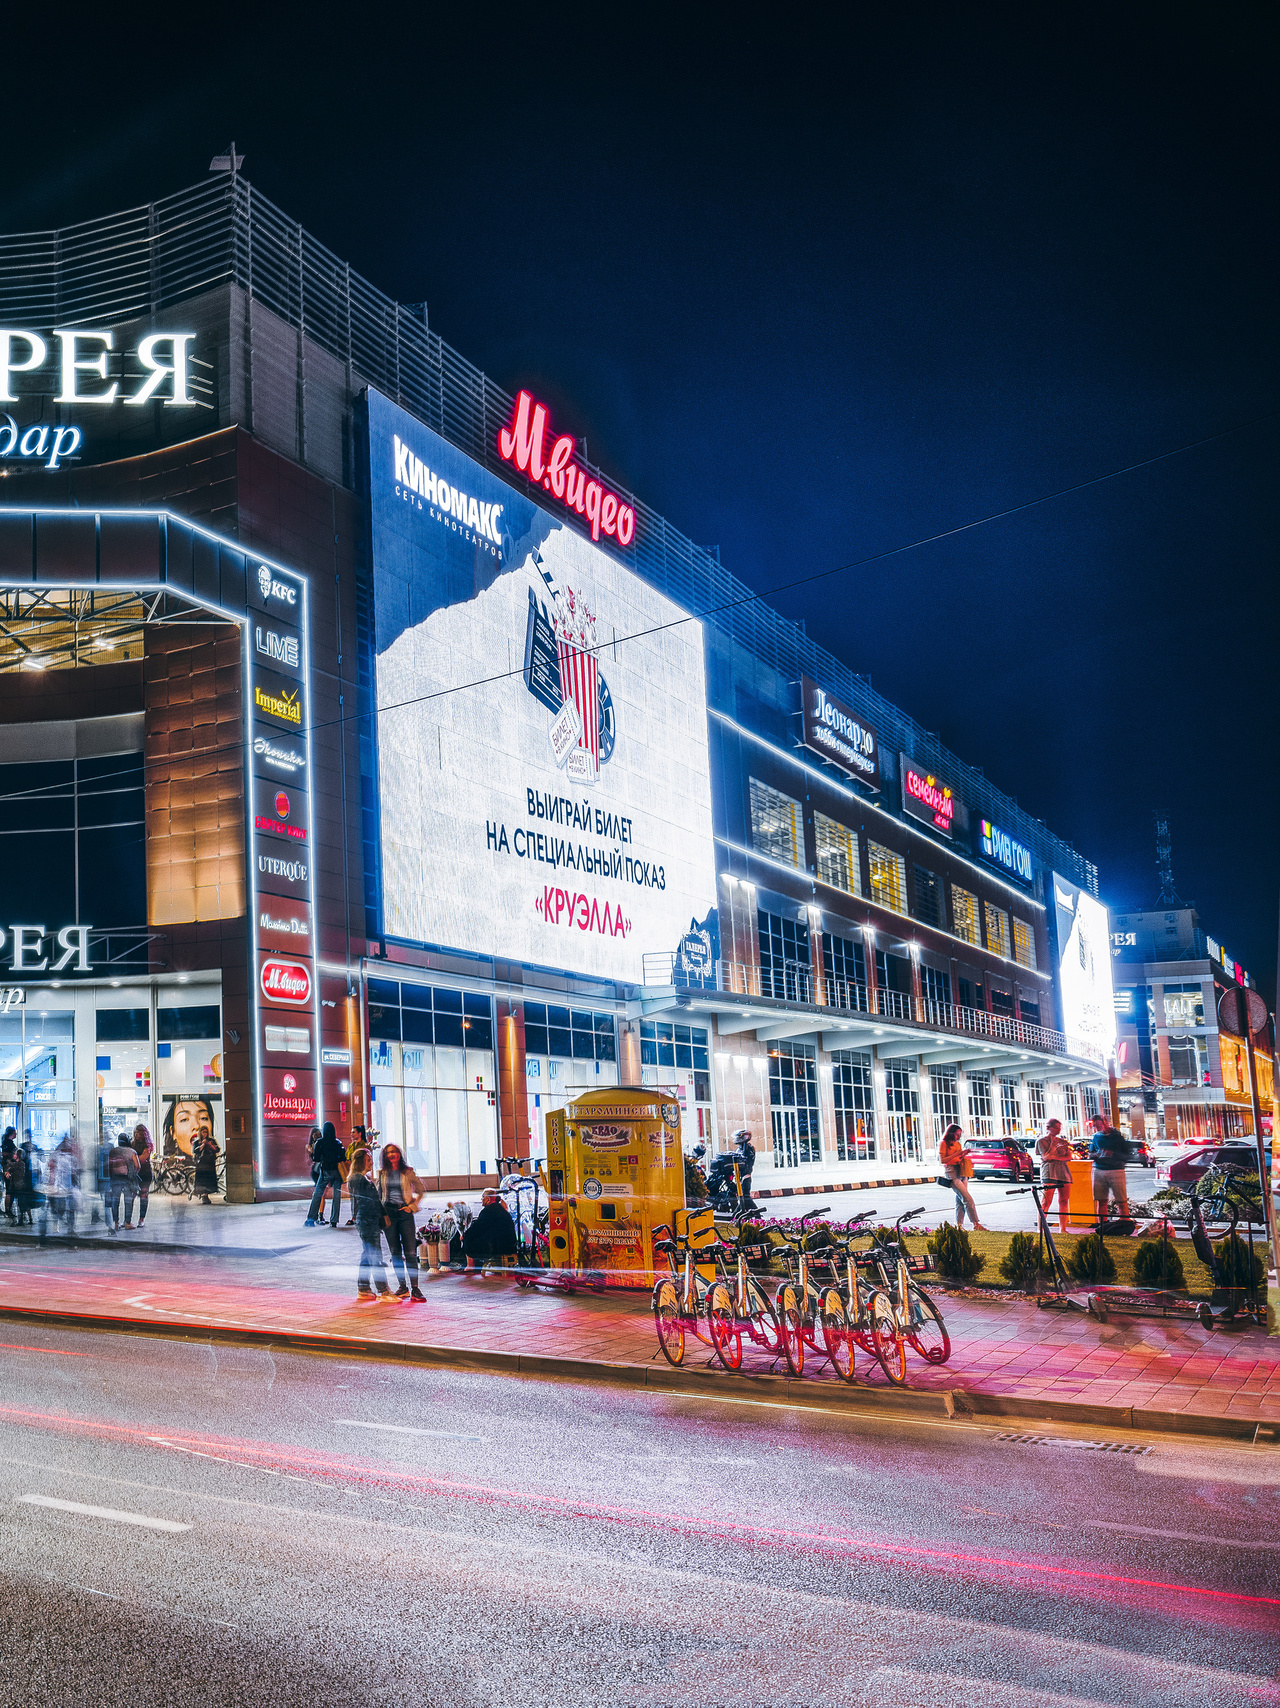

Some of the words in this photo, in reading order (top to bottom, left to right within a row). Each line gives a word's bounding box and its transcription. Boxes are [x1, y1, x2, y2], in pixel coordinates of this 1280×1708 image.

[499, 390, 635, 545] М.видео
[394, 434, 503, 545] КИНОМАКС
[395, 485, 422, 510] СЕТЬ
[430, 507, 503, 560] КИНОТЕАТРОВ
[271, 580, 297, 605] KFC
[256, 626, 299, 668] LIME
[255, 687, 301, 720] Imperial
[814, 688, 874, 756] Леонардо
[255, 816, 286, 834] БУРГЕР
[287, 824, 307, 839] КИНГ
[526, 787, 592, 833] ВЫИГРАЙ
[595, 808, 633, 844] БИЛЕТ
[258, 855, 308, 881] UTERQÜE
[486, 820, 510, 854] НА
[514, 828, 623, 880] СПЕЦИАЛЬНЫЙ
[626, 857, 666, 890] ПОКАЗ
[992, 826, 1012, 867] РИВ
[1012, 840, 1032, 881] ГОШ
[260, 913, 290, 931] Massimo
[291, 918, 309, 935] Dutti
[535, 885, 632, 939] «КРУЭЛЛА»
[265, 968, 307, 995] М.видео
[263, 1093, 316, 1112] Леонардо
[551, 1118, 559, 1155] КВАС
